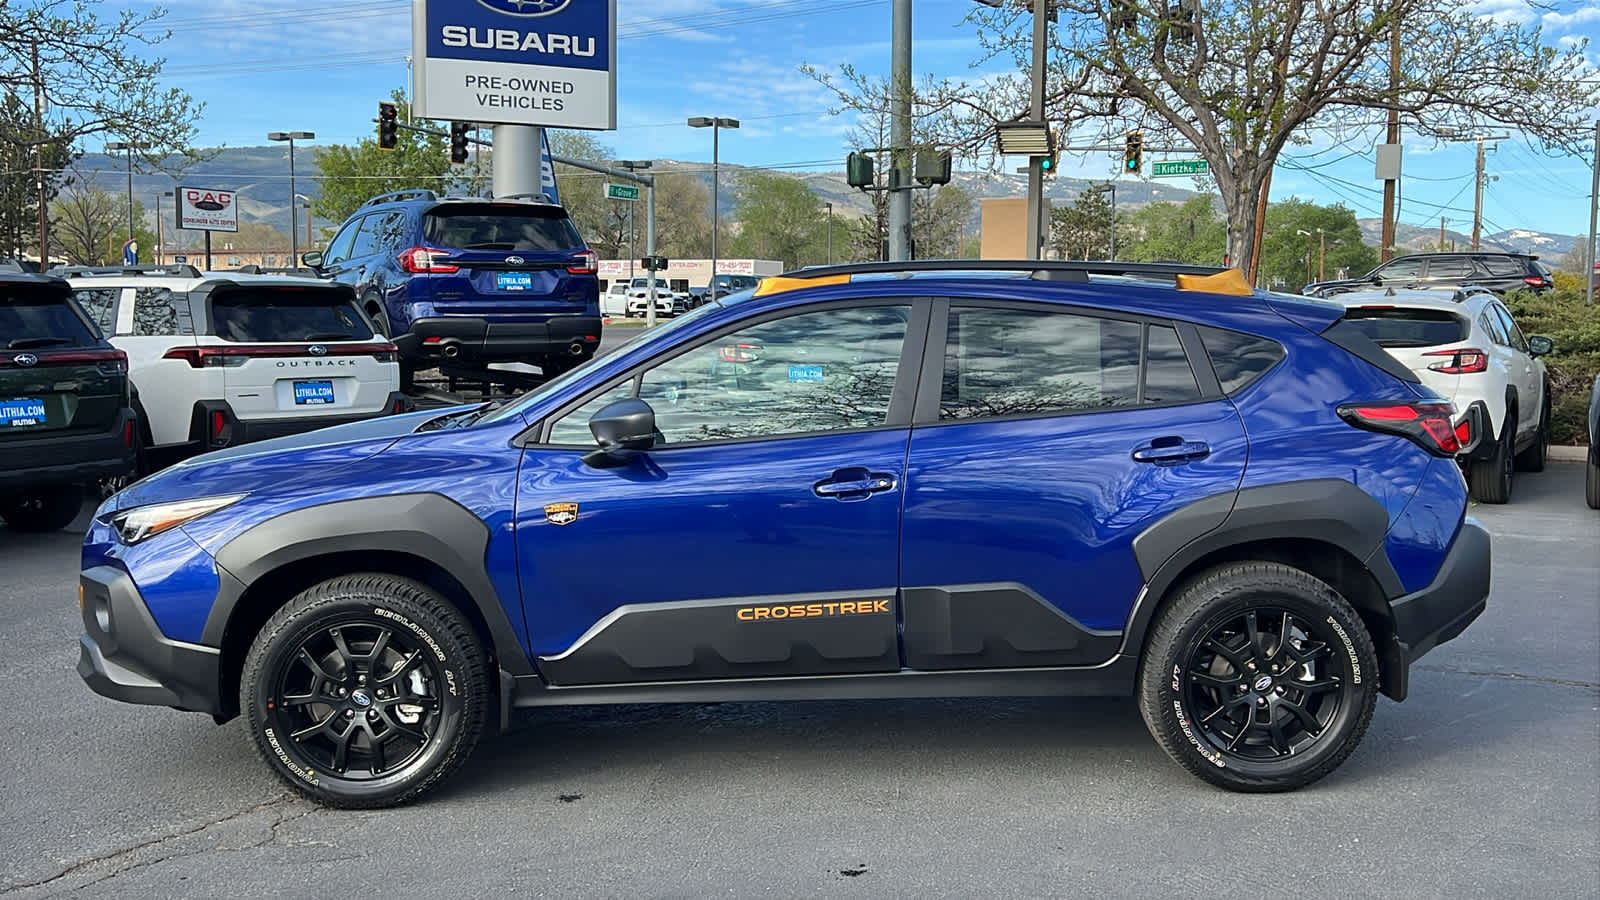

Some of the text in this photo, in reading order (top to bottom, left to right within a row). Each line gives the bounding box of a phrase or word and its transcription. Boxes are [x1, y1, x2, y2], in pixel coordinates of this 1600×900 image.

[442, 25, 596, 57] SUBARU
[465, 75, 574, 94] PRE-OWNED
[476, 94, 564, 111] VEHICLES
[187, 191, 231, 203] CAC
[275, 359, 356, 368] OUTBACK
[296, 387, 333, 398] LITHIA.COM
[0, 405, 45, 418] LITHIA.COM
[737, 600, 889, 621] CROSSTREK
[1326, 615, 1362, 685] YOKOHAMA
[264, 727, 320, 787] YOKOHAMA
